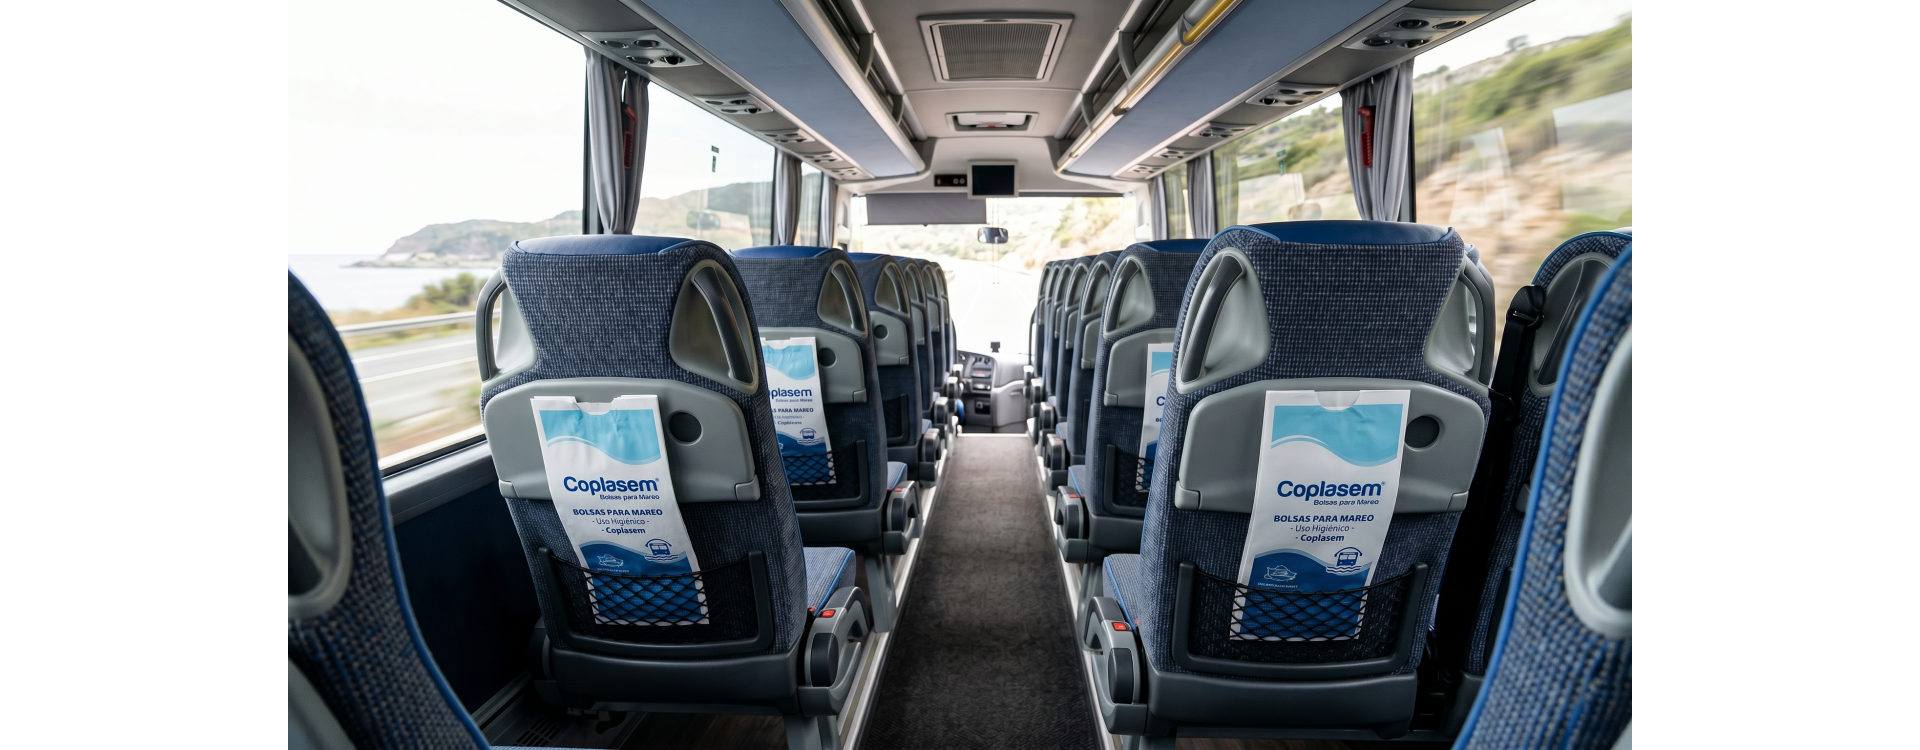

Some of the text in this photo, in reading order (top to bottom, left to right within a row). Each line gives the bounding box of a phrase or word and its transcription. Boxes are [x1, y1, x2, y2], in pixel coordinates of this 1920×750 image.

[768, 387, 813, 400] plasem
[595, 517, 610, 525] Uso
[611, 517, 646, 526] Higiénico
[1273, 514, 1375, 523] BOLSAS PARA MAREO
[605, 527, 646, 535] Coplasem
[1311, 525, 1350, 533] Higiénico
[1300, 534, 1345, 543] Coplasem
